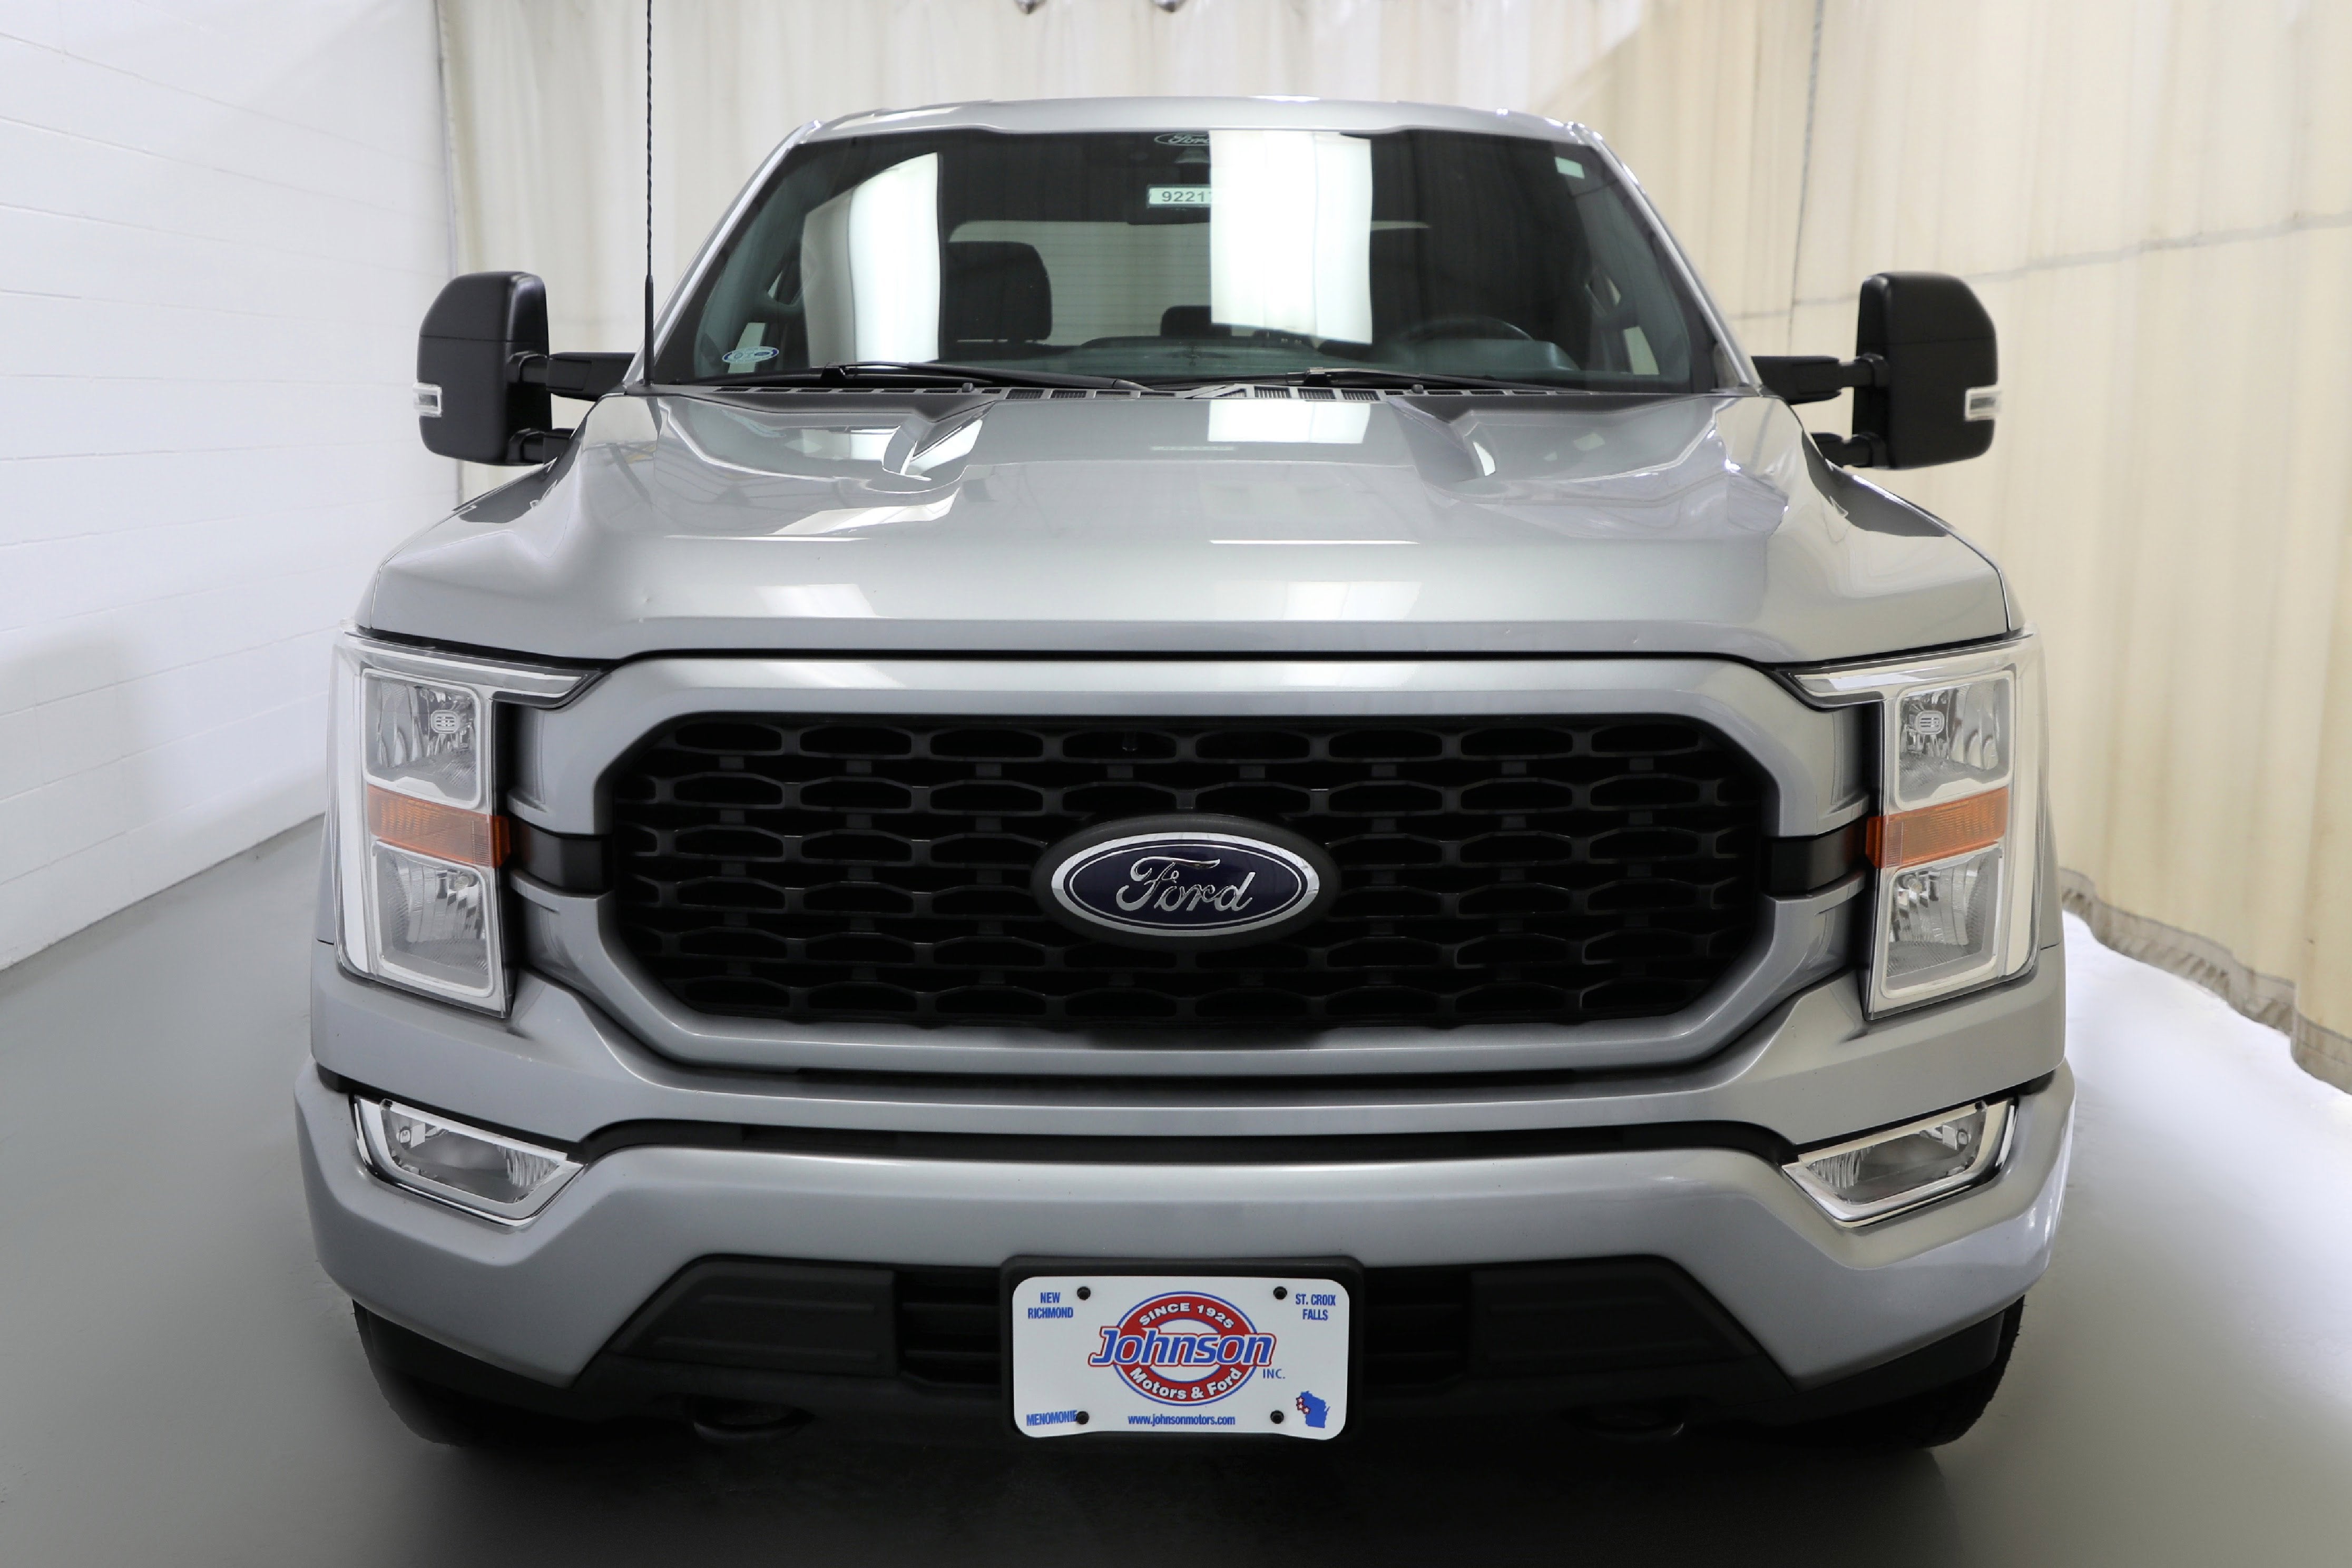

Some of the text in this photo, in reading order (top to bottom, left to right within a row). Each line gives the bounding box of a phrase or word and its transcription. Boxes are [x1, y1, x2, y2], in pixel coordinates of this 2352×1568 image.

[1162, 191, 1211, 202] 9221
[1116, 856, 1256, 912] Ford
[1040, 1292, 1061, 1304] NEW
[1296, 1293, 1336, 1306] ST. CROIX
[1028, 1307, 1074, 1319] RICHMOND
[1139, 1302, 1234, 1328] SINCE 1925
[1302, 1309, 1329, 1321] FALLS
[1091, 1328, 1275, 1365] Johnson
[1262, 1368, 1286, 1379] INC.
[1130, 1367, 1243, 1399] Motors & Ford
[1026, 1410, 1077, 1426] MENOMONIE
[1128, 1414, 1236, 1427] www.johnsonmotors.com
